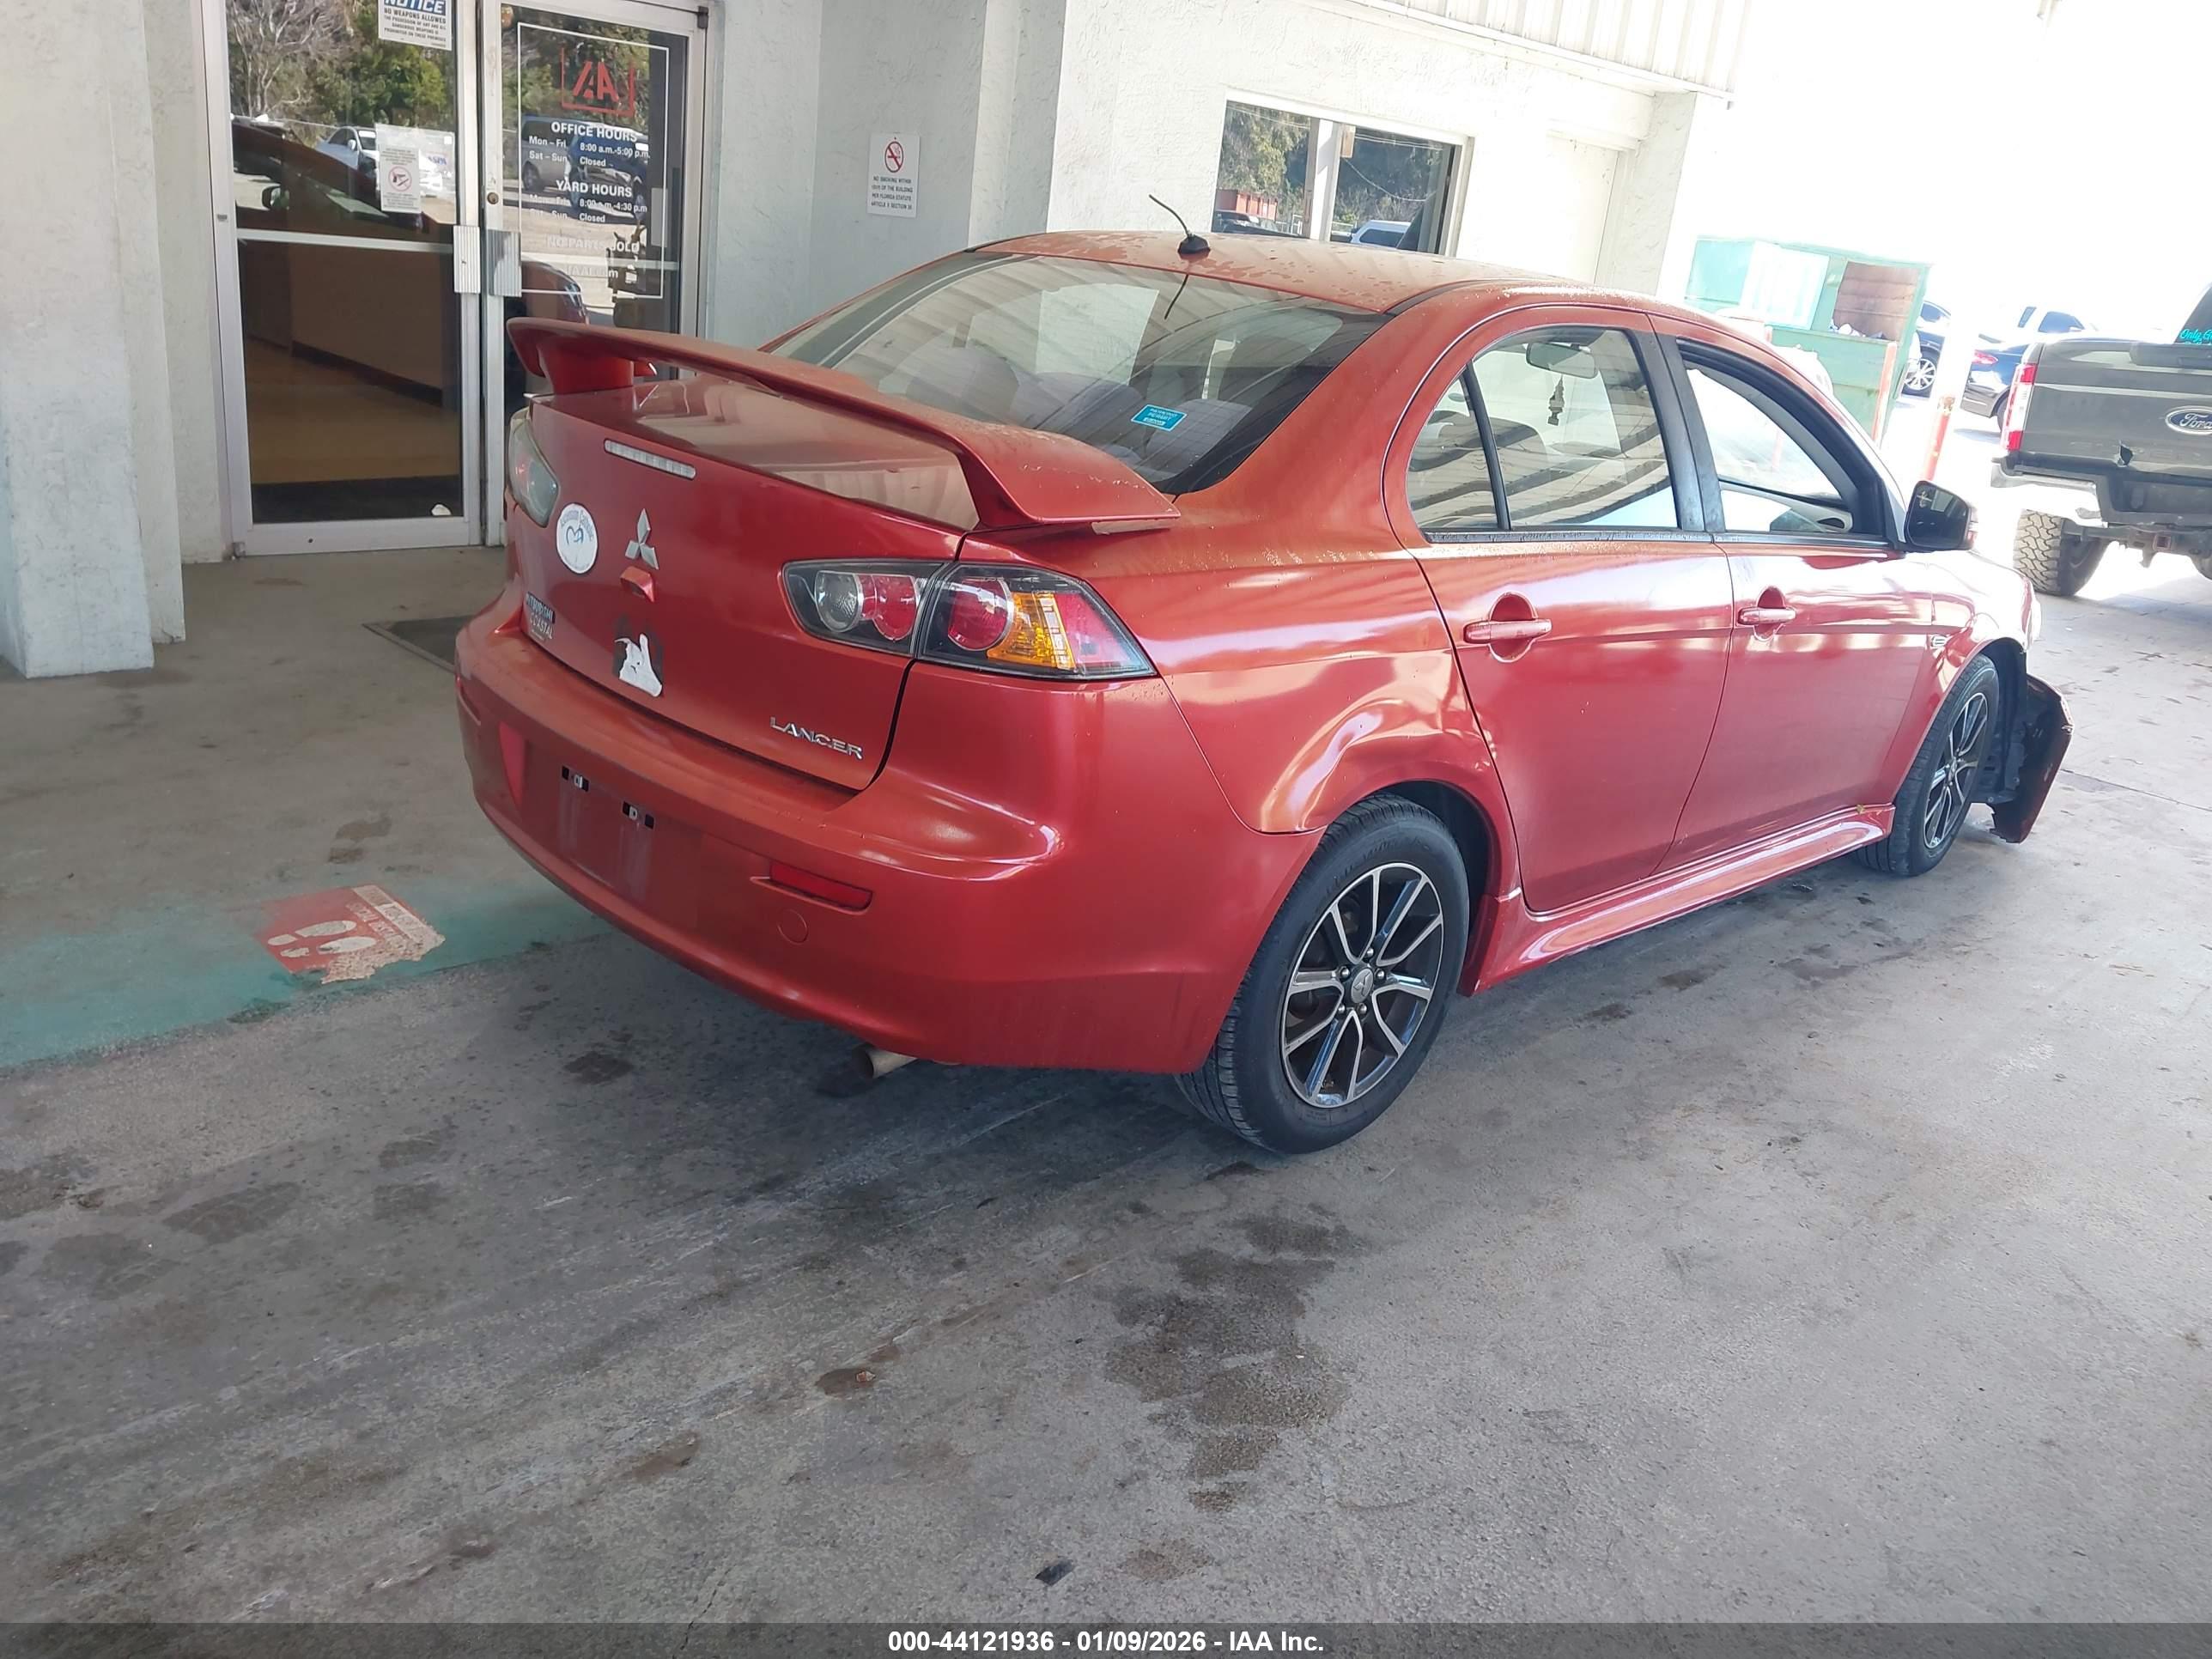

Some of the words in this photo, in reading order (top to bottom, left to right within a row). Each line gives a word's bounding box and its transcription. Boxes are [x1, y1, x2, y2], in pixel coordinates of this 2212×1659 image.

[393, 9, 420, 19] WEAPONS
[422, 14, 446, 24] ALLOWED
[551, 121, 593, 137] OFFICE
[597, 128, 637, 143] HOURS
[529, 136, 548, 146] Mon
[580, 143, 597, 152] 8:00
[529, 150, 543, 161] Sat
[551, 153, 567, 162] Sun
[580, 156, 606, 167] Closed
[556, 180, 588, 193] YARD
[592, 184, 633, 198] HOURS
[580, 198, 597, 209] 8:00
[551, 210, 568, 220] Sun
[579, 213, 605, 223] Closed
[770, 716, 862, 759] LANCER
